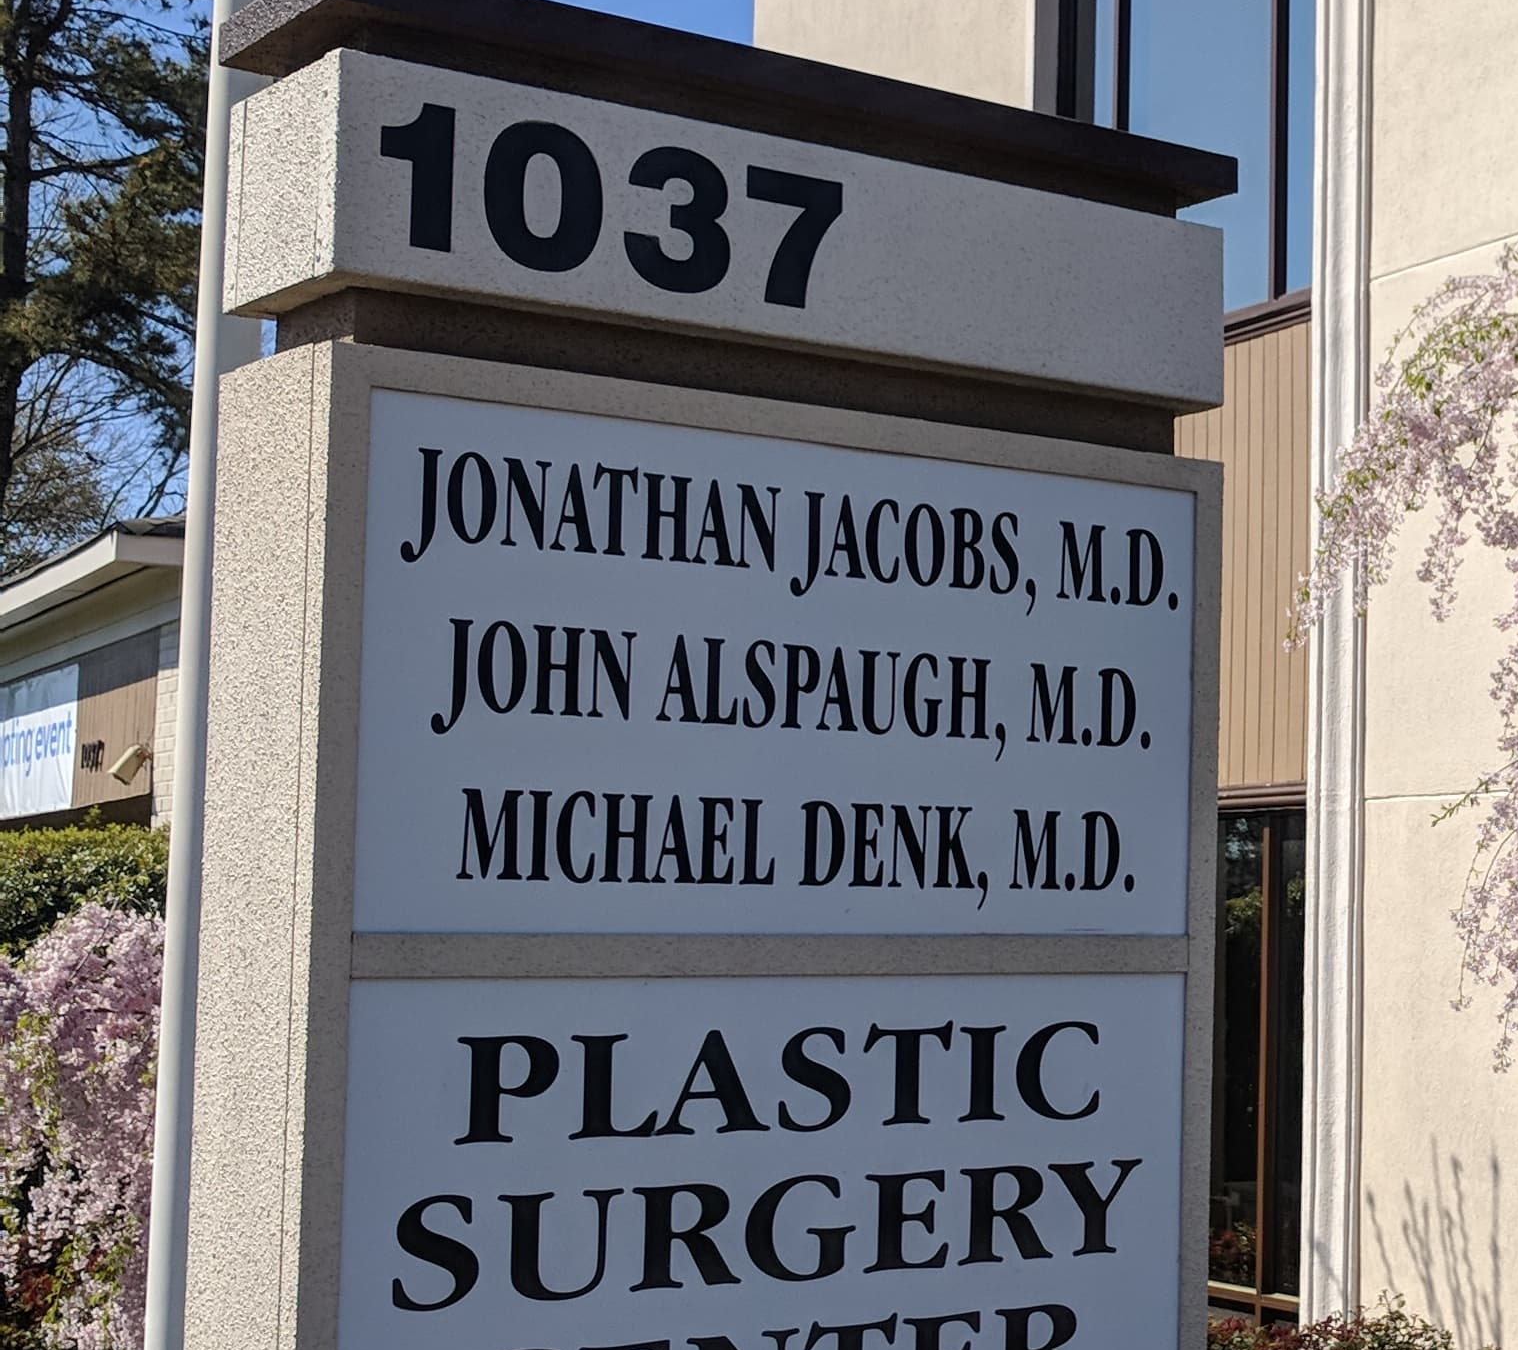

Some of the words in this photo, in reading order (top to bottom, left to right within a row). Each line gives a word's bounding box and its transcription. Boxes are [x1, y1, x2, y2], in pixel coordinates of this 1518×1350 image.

[380, 103, 844, 309] 1037
[400, 447, 782, 573] JONATHAN
[790, 490, 1036, 616] JACOBS,
[1056, 520, 1179, 611] M.D.
[35, 710, 72, 760] event
[430, 618, 638, 735] JOHN
[655, 634, 1006, 762] ALSPAUGH,
[1026, 663, 1151, 750] M.D.
[455, 787, 775, 886] MICHAEL
[798, 800, 988, 911] DENK,
[1009, 809, 1135, 893] M.D.
[453, 1019, 1100, 1146] PLASTIC
[392, 1158, 1143, 1312] SURGERY
